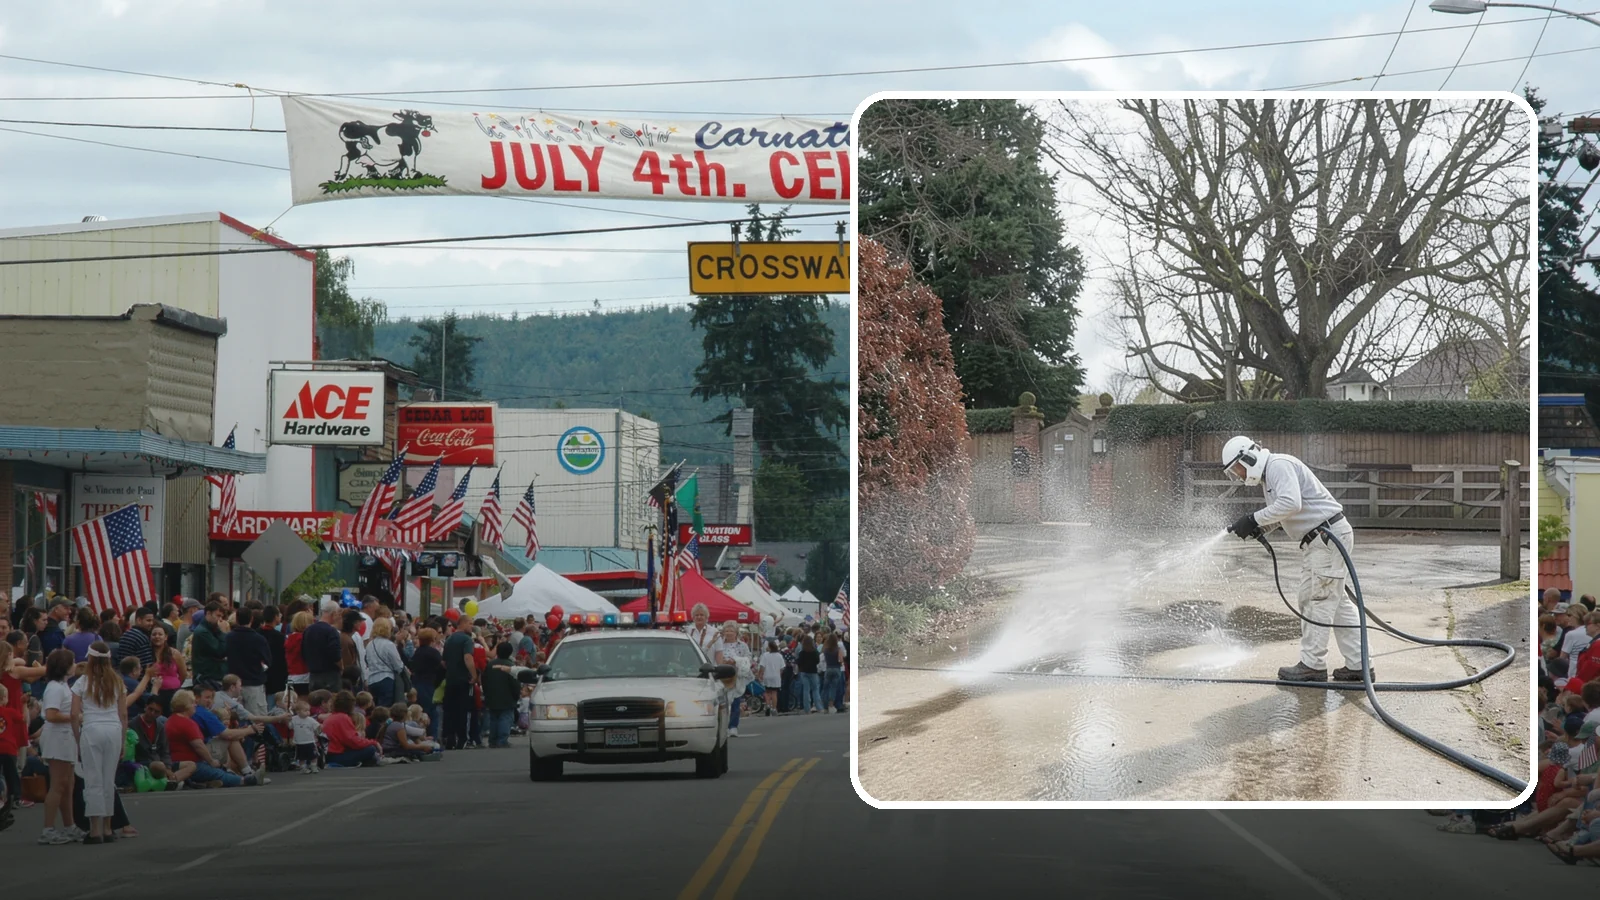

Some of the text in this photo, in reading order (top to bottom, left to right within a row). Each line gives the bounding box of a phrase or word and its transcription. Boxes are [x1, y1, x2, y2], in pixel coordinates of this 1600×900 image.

[695, 121, 850, 149] Carnat
[481, 141, 604, 192] JULY
[632, 150, 746, 197] 4th.
[697, 254, 850, 279] CROSSWA
[283, 380, 373, 419] ACE
[406, 409, 484, 421] CEDAR LOG
[284, 421, 370, 436] Hardware
[416, 428, 476, 446] Coca-Cola
[83, 485, 155, 494] St. Vincent de Paul
[213, 516, 330, 535] HARDARE
[688, 527, 741, 535] CRNATION
